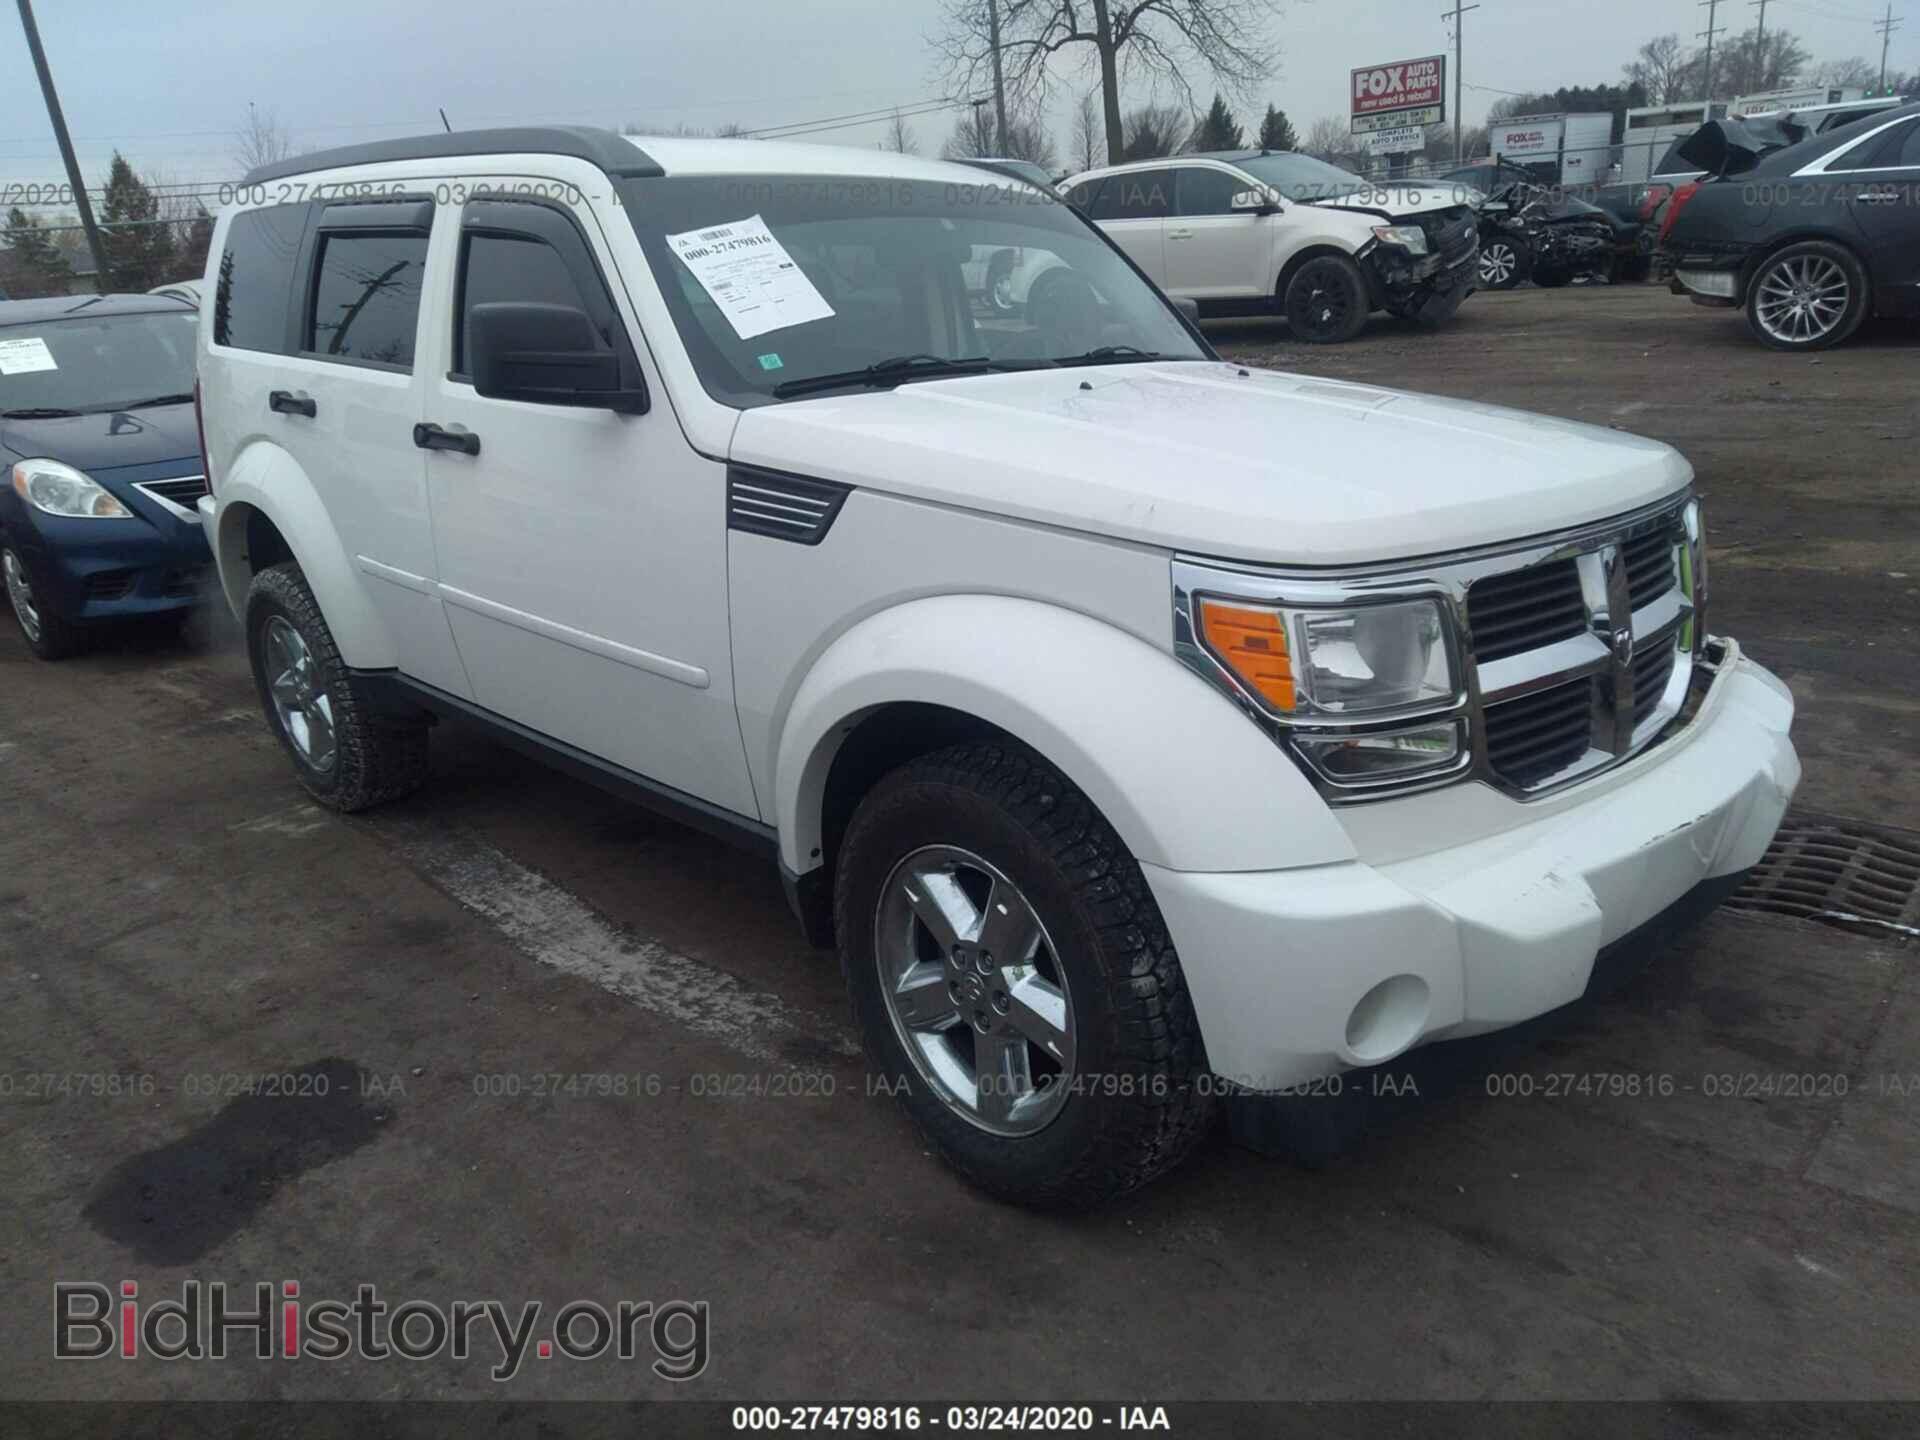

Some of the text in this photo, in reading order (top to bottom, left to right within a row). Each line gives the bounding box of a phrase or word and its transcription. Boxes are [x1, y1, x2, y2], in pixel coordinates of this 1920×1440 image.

[1408, 62, 1435, 77] AUTO
[1356, 66, 1405, 98] FOX
[1407, 75, 1438, 90] PARTS
[1371, 133, 1420, 145] AUTO SERVICE
[1377, 128, 1414, 137] COMPLETE
[1506, 132, 1528, 144] FOX
[684, 234, 772, 261] 000-27479816
